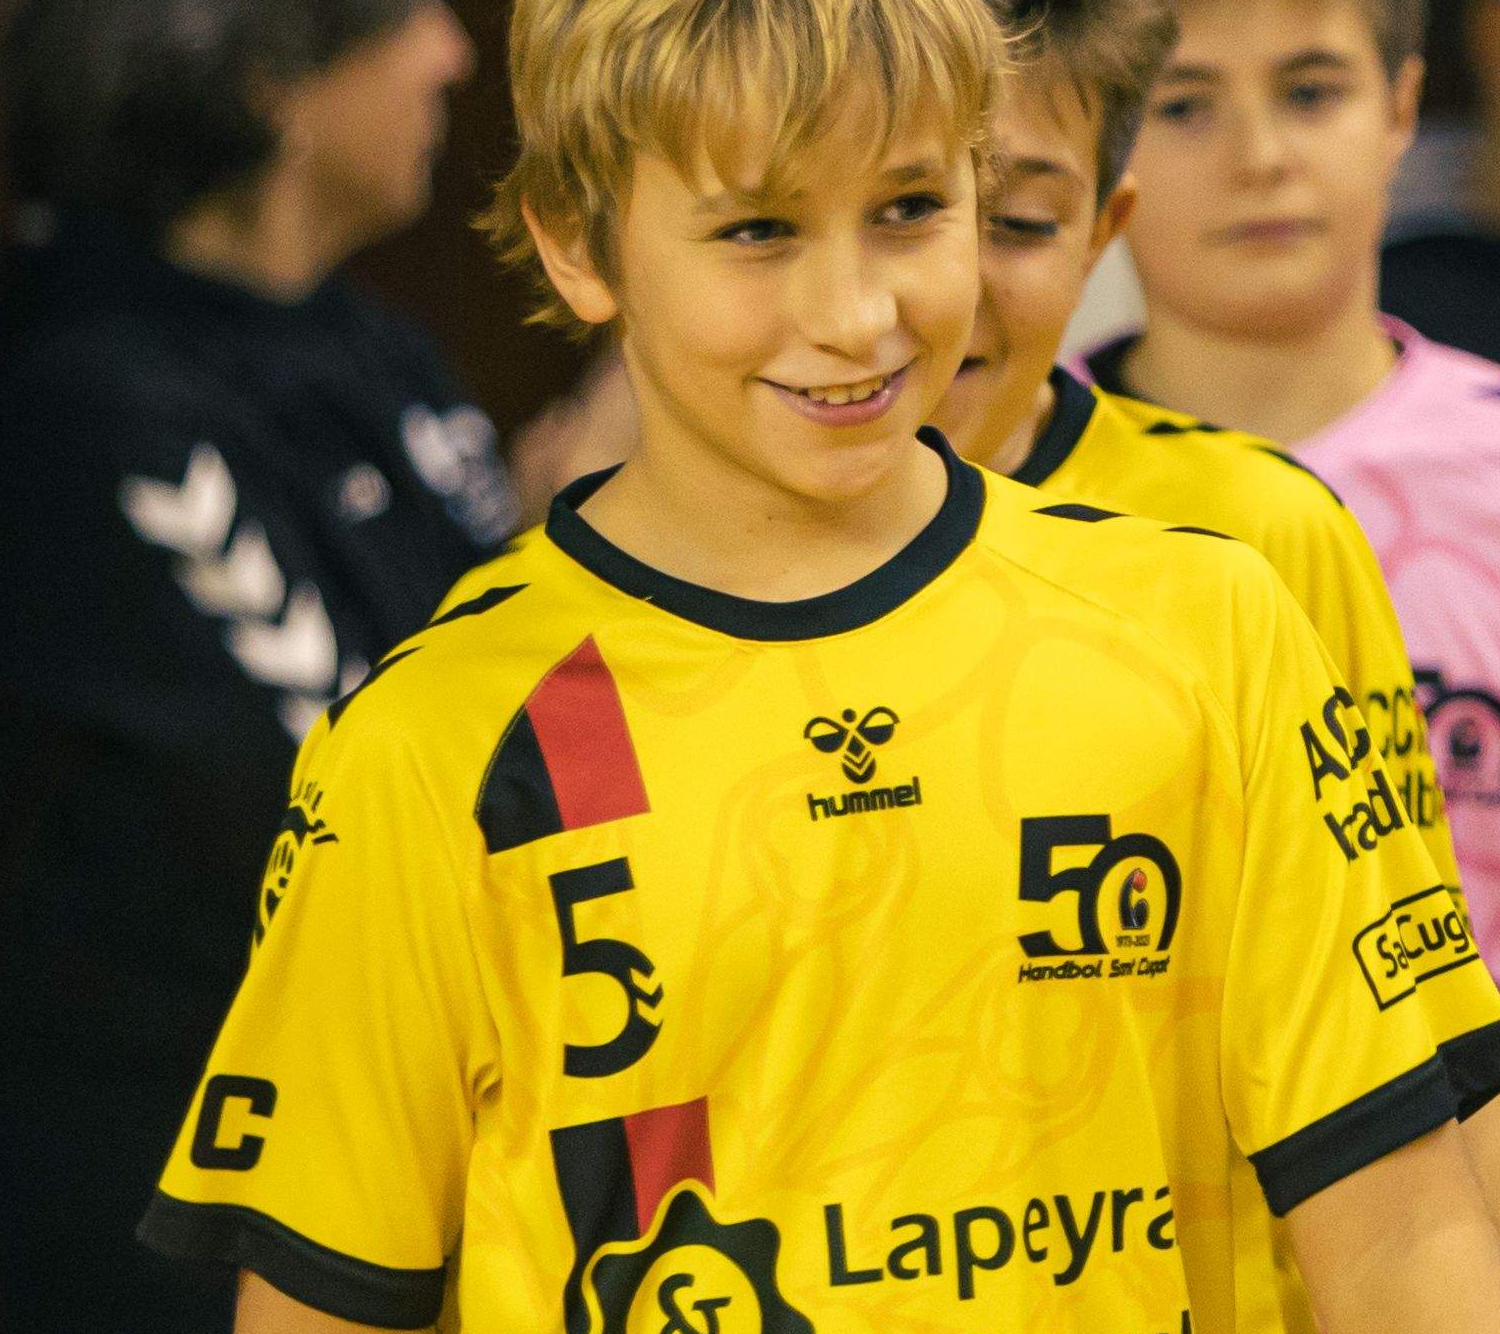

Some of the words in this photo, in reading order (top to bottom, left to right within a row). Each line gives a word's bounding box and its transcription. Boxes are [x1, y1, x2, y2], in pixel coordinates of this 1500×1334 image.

[806, 776, 923, 821] hummel
[1017, 814, 1183, 958] 50
[548, 856, 665, 1079] 5
[1018, 959, 1103, 984] Handbol
[190, 1074, 278, 1171] C
[823, 1185, 1177, 1301] Lapeyra
